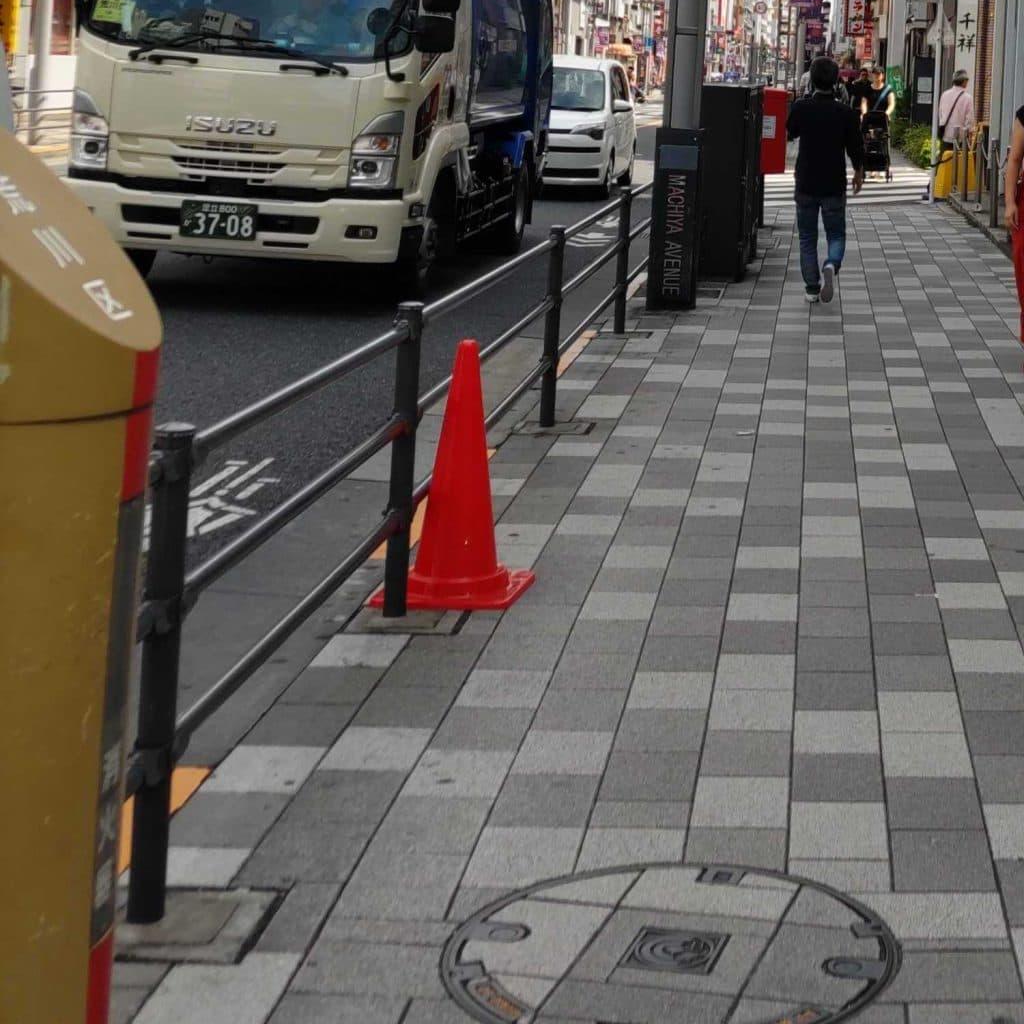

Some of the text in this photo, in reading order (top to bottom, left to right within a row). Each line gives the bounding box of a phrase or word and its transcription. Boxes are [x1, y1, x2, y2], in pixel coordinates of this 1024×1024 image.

[185, 115, 278, 137] ISUZU
[192, 212, 254, 238] 37-08
[662, 174, 687, 297] MACHIYA AVENUE
